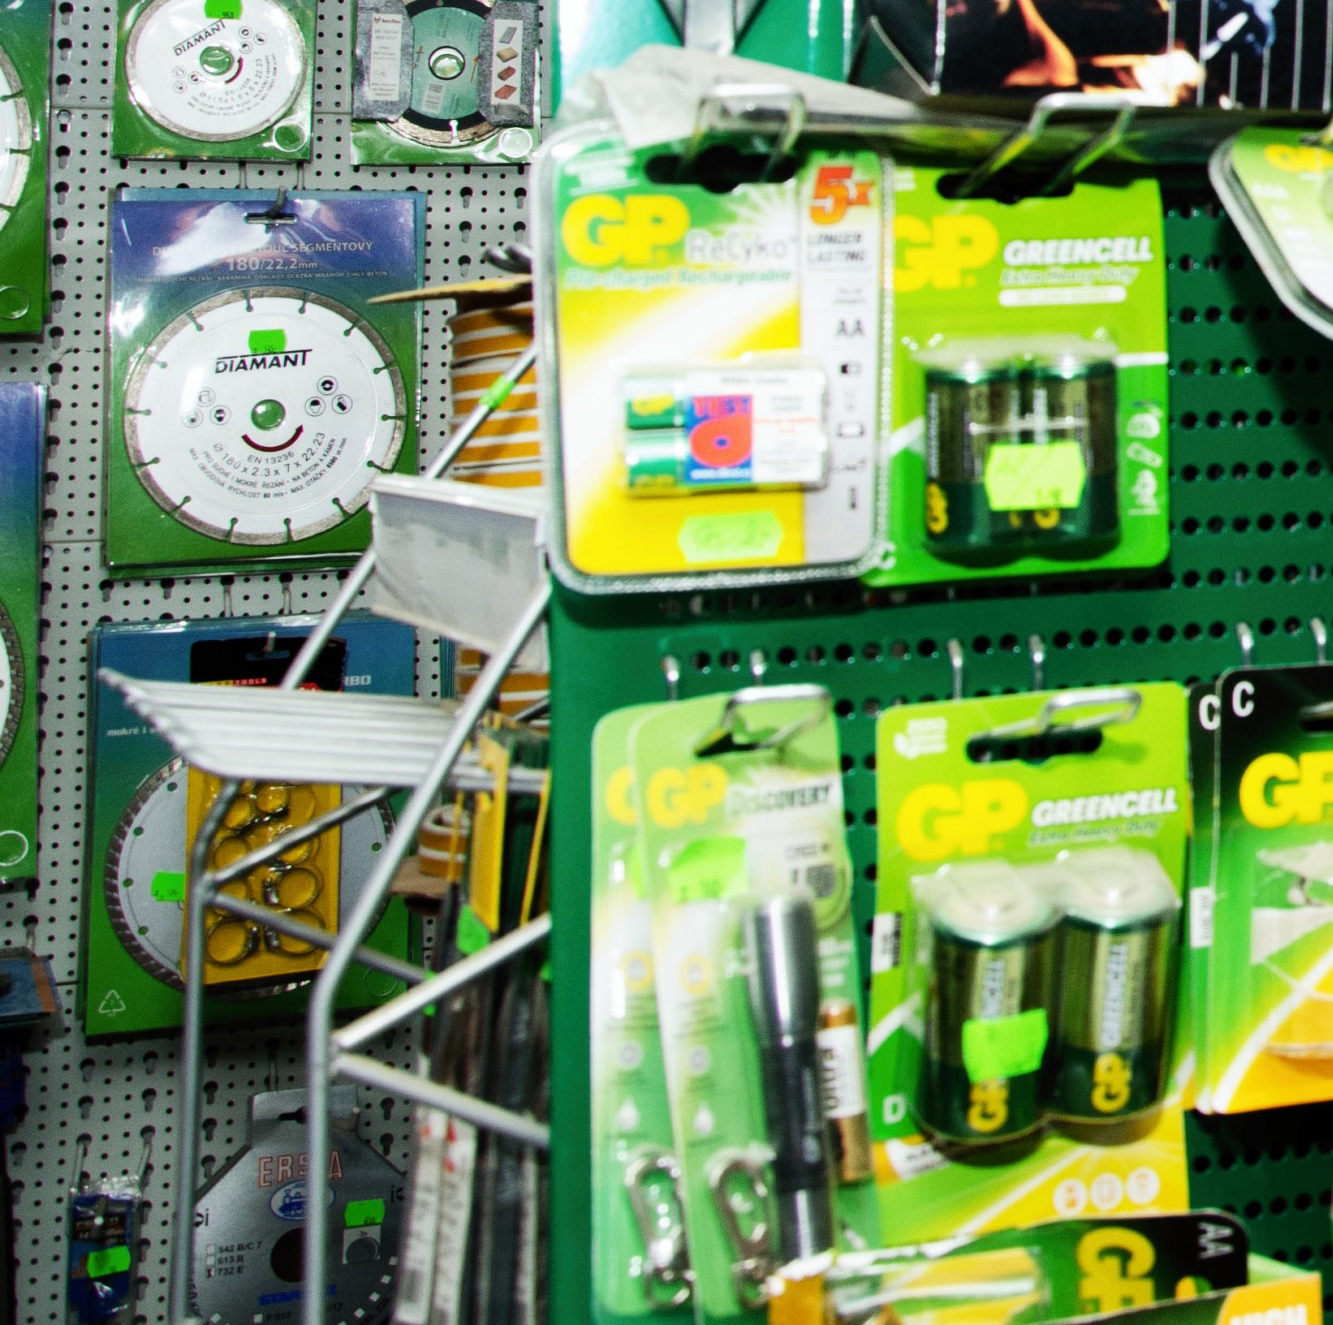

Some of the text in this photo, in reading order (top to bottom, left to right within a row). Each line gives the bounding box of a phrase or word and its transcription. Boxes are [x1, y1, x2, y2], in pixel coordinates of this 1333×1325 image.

[809, 165, 874, 225] 5x
[292, 240, 373, 254] SEGMENTOVÝ
[561, 194, 691, 267] GP
[894, 213, 1154, 293] GP GREENCELL
[835, 320, 866, 338] AA
[215, 349, 312, 374] DIAMANT
[1199, 695, 1220, 730] C
[1232, 682, 1254, 717] C
[646, 763, 729, 829] GP
[895, 778, 1179, 862] GP GREENCELL
[1093, 1052, 1133, 1112] GP
[883, 1093, 905, 1123] D
[1197, 1222, 1234, 1258] AA
